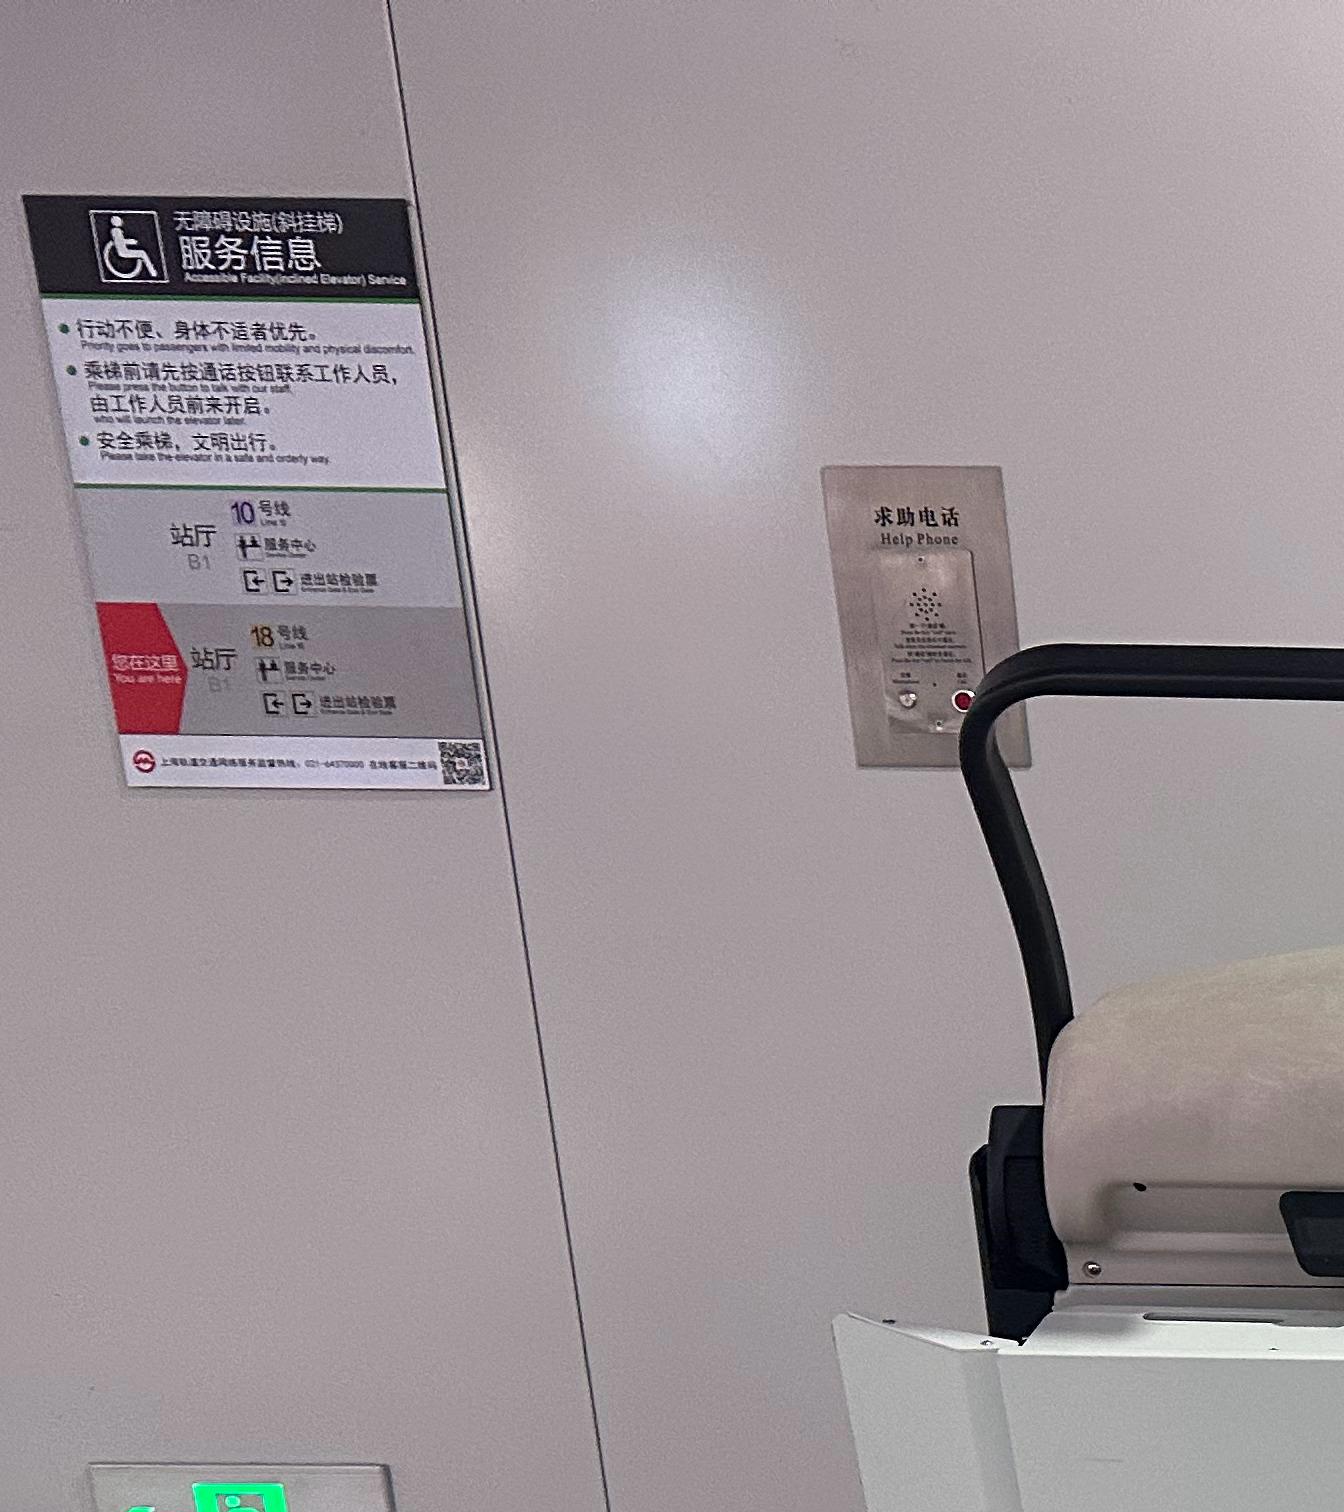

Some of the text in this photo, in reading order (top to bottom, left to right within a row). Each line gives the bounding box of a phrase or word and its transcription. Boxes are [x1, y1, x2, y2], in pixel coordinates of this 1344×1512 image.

[173, 210, 344, 234] 无障碍设施(斜挂梯)
[178, 234, 322, 272] 服务信息
[367, 275, 406, 286] Service
[76, 318, 316, 341] 行动不便、身体不适者优先。
[84, 361, 398, 385] 乘梯前请先按通话按钮联系工作人员，
[90, 393, 270, 415] 由工作人员前来开启。
[97, 430, 276, 453] 安全乘梯，文明出行。
[231, 500, 292, 524] 10 号线
[874, 506, 960, 527] 求助电话
[169, 523, 217, 548] 站厅
[881, 533, 959, 549] Help Phone
[187, 554, 211, 571] B1
[250, 626, 275, 648] 18
[276, 624, 309, 641] 号线
[112, 653, 181, 672] 您在这里
[190, 647, 238, 671] 站厅
[113, 673, 182, 685] You are here
